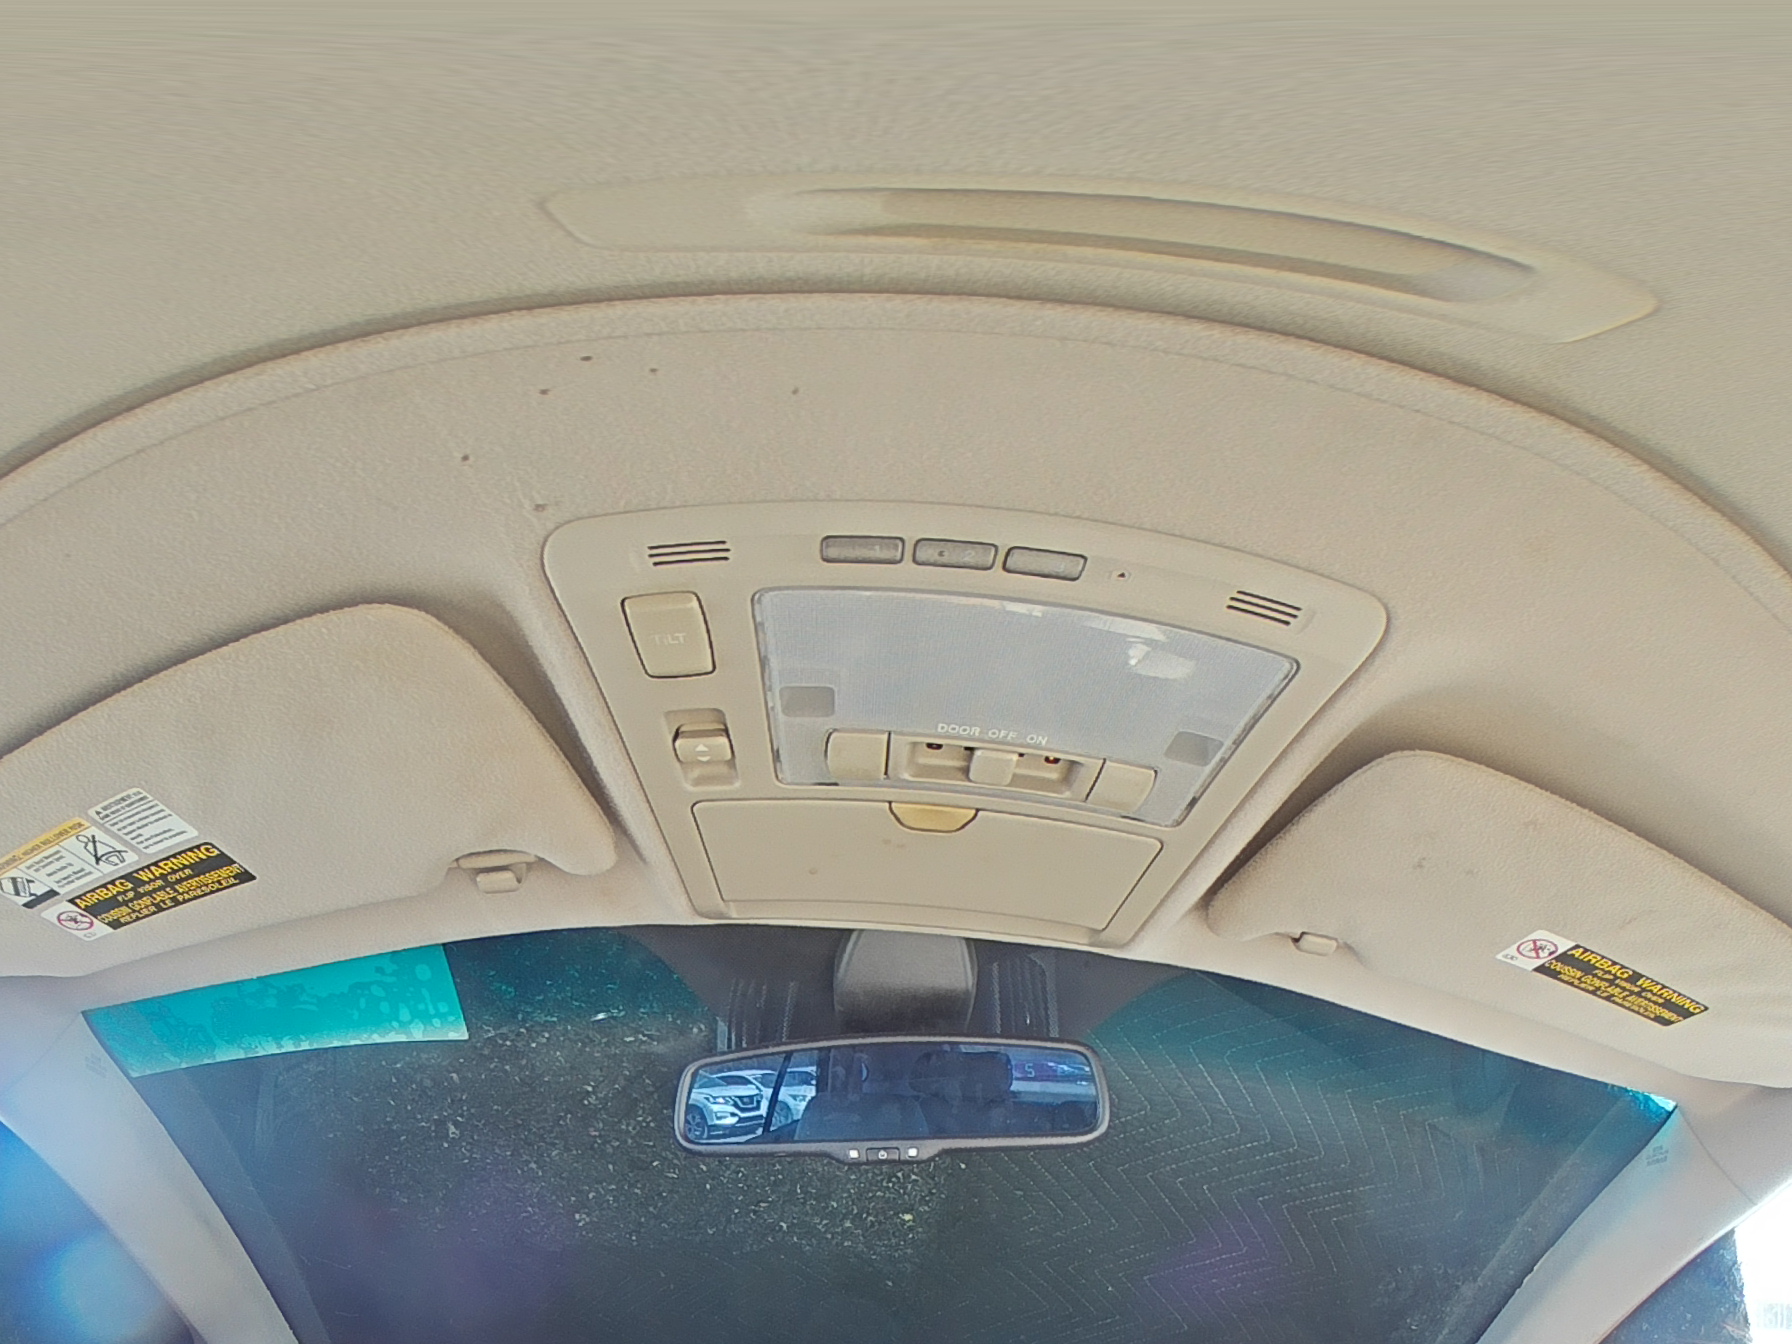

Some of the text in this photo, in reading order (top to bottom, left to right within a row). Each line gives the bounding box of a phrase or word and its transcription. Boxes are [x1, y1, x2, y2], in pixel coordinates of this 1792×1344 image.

[962, 551, 974, 562] 2
[651, 632, 686, 645] TILT
[937, 723, 1048, 746] DOOR OFF ON
[74, 878, 134, 909] AIRBAG
[132, 845, 221, 882] WARNING
[117, 891, 135, 902] FLIP
[168, 868, 193, 882] OVER
[119, 905, 158, 923] REPLIER
[160, 899, 175, 908] LE
[1567, 948, 1705, 1013] AIRBAG WARNING
